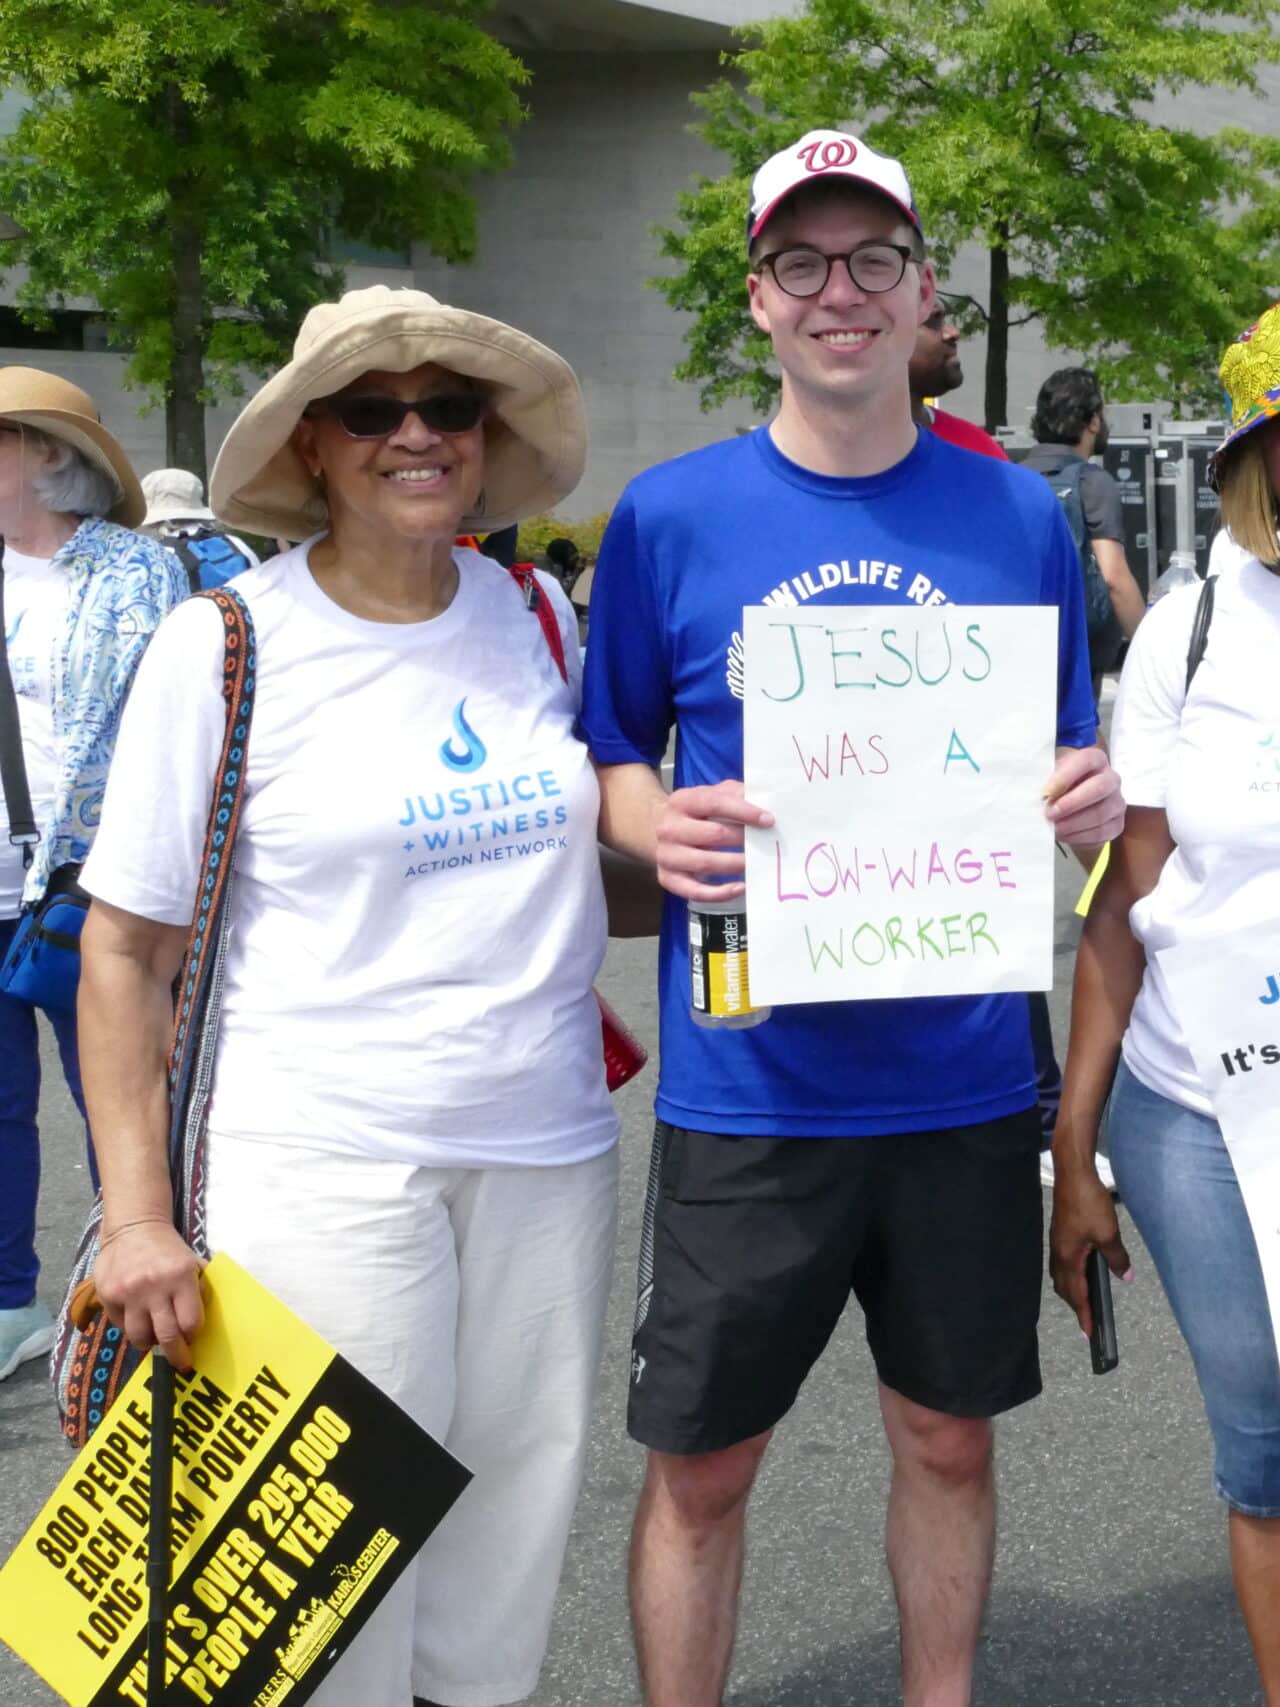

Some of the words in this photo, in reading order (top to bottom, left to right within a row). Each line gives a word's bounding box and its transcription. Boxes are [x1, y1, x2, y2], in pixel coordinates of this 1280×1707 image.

[797, 138, 858, 172] W
[761, 560, 903, 608] WILDLIFE
[905, 573, 958, 608] RE
[761, 621, 991, 702] JESUS
[792, 731, 889, 783] WAS
[943, 728, 981, 774] A
[399, 769, 561, 826] JUSTICE
[424, 805, 568, 850] WITNESS
[404, 853, 473, 878] ACTION
[479, 836, 568, 862] NETWORK
[775, 839, 1017, 902] LOW-WAGE
[804, 912, 1000, 972] WORKER
[1219, 1042, 1280, 1078] It's
[36, 1504, 91, 1570] 800
[73, 1400, 152, 1512] PEOPLE
[77, 1491, 205, 1660] LONG-TM
[188, 1365, 291, 1502] POVERTY
[192, 1527, 266, 1610] OVER
[247, 1404, 352, 1536] 295,000
[277, 1481, 355, 1568] YEAR
[64, 1518, 133, 1602] EACH
[258, 1559, 299, 1600] A
[180, 1584, 278, 1705] PEOPLE
